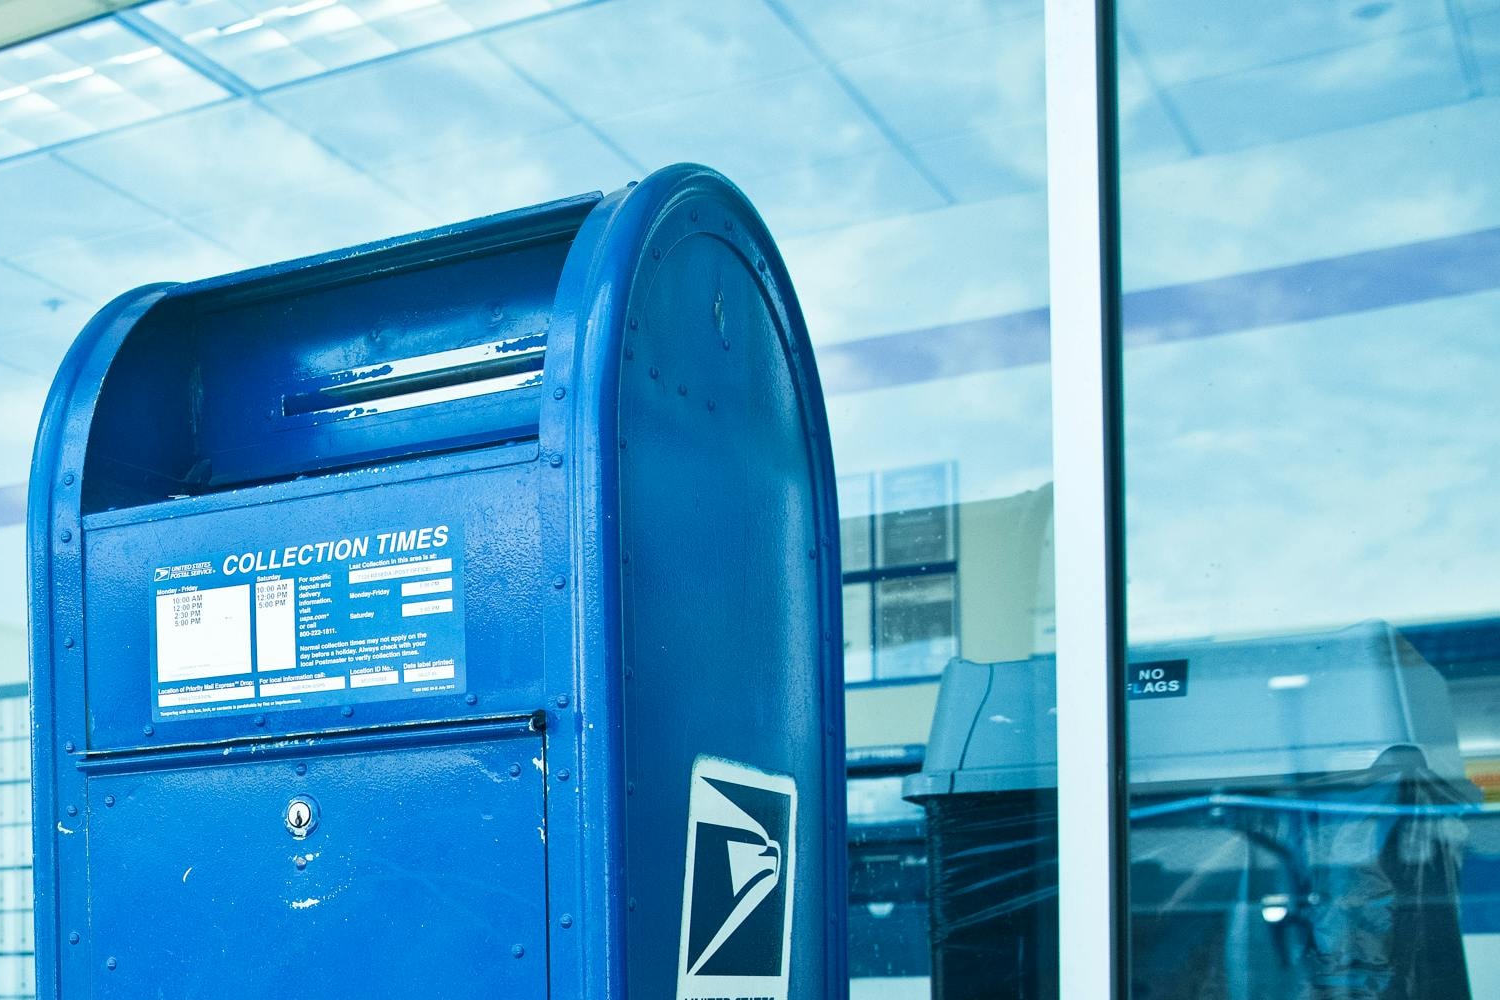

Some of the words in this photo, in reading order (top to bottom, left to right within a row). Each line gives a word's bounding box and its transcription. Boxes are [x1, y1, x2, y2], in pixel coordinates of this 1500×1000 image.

[223, 536, 368, 576] COLLECTION
[376, 526, 448, 554] TIMES
[257, 574, 281, 582] Saturday
[309, 574, 331, 582] specific
[157, 588, 177, 596] Monday
[257, 585, 274, 593] 10:00
[257, 593, 274, 601] 12:00
[299, 591, 321, 599] delivery
[349, 589, 390, 599] Monday-Friday
[173, 596, 190, 604] 10:00
[192, 594, 203, 602] AM
[174, 604, 190, 612] 12:00
[192, 602, 202, 610] PM
[350, 611, 374, 619] Saturday
[300, 643, 320, 651] Normal
[321, 641, 349, 650] collection
[367, 638, 379, 646] may
[391, 634, 406, 643] apply
[300, 653, 310, 661] day
[311, 650, 330, 658] before
[359, 645, 379, 654] Always
[412, 641, 426, 649] your
[315, 656, 346, 665] Postmaster
[372, 652, 400, 660] collection
[350, 666, 373, 675] Location
[1139, 668, 1164, 680] NO
[282, 673, 313, 681] information
[158, 687, 179, 695] Location
[186, 685, 203, 693] Priority
